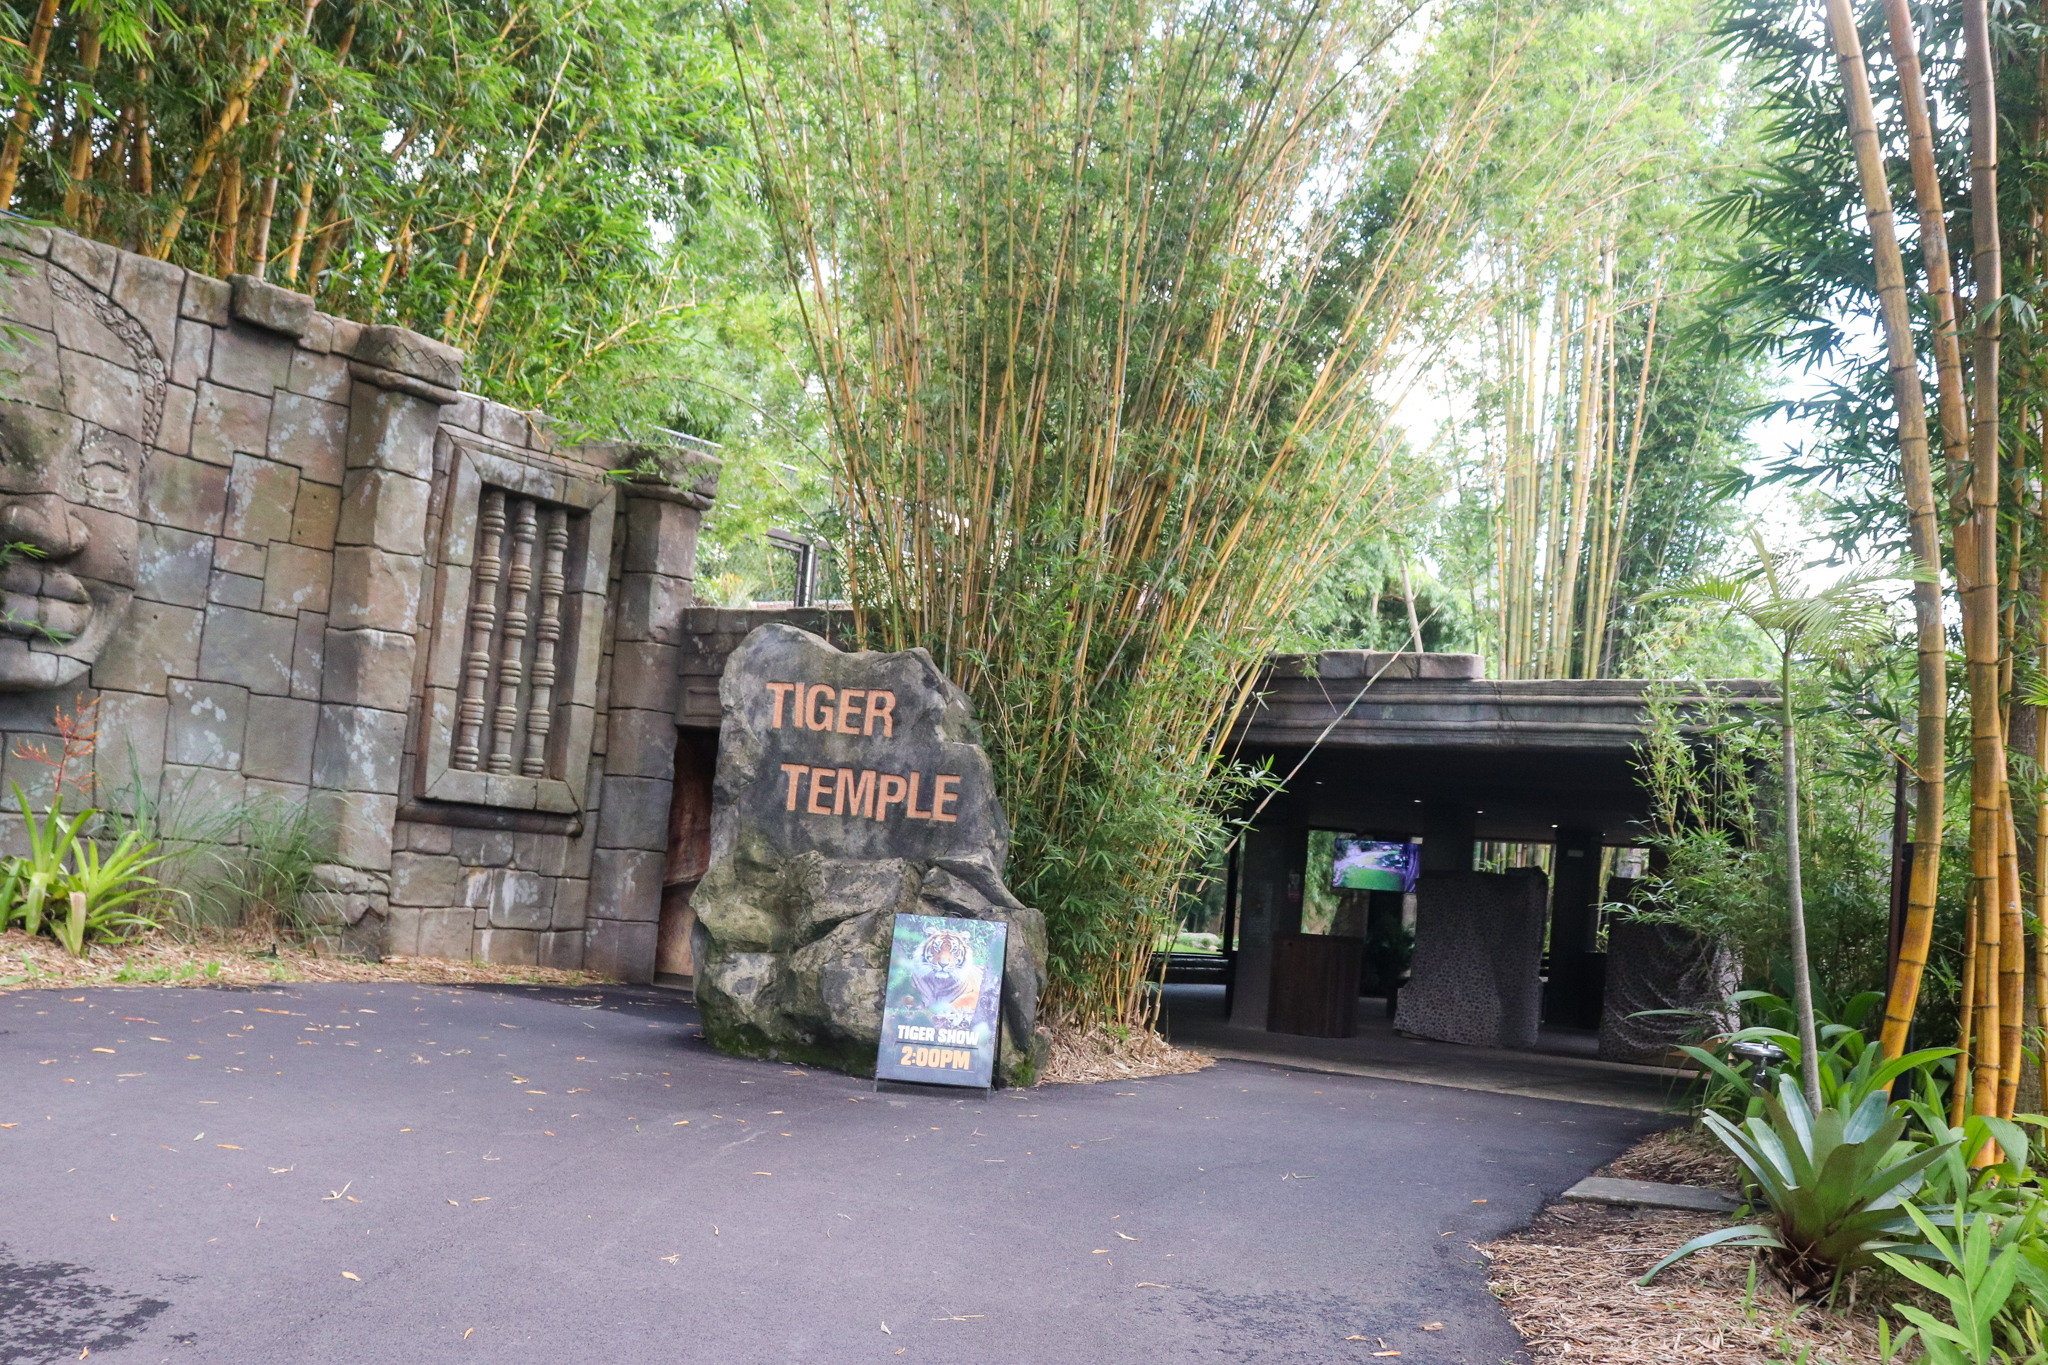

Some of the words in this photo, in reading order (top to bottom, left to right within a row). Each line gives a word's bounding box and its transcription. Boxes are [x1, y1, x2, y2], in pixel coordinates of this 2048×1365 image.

[766, 682, 896, 738] TIGER
[780, 763, 961, 823] TEMPLE
[898, 1025, 935, 1041] TIGER
[937, 1028, 980, 1045] SHOW
[900, 1046, 971, 1070] 2:00PM
